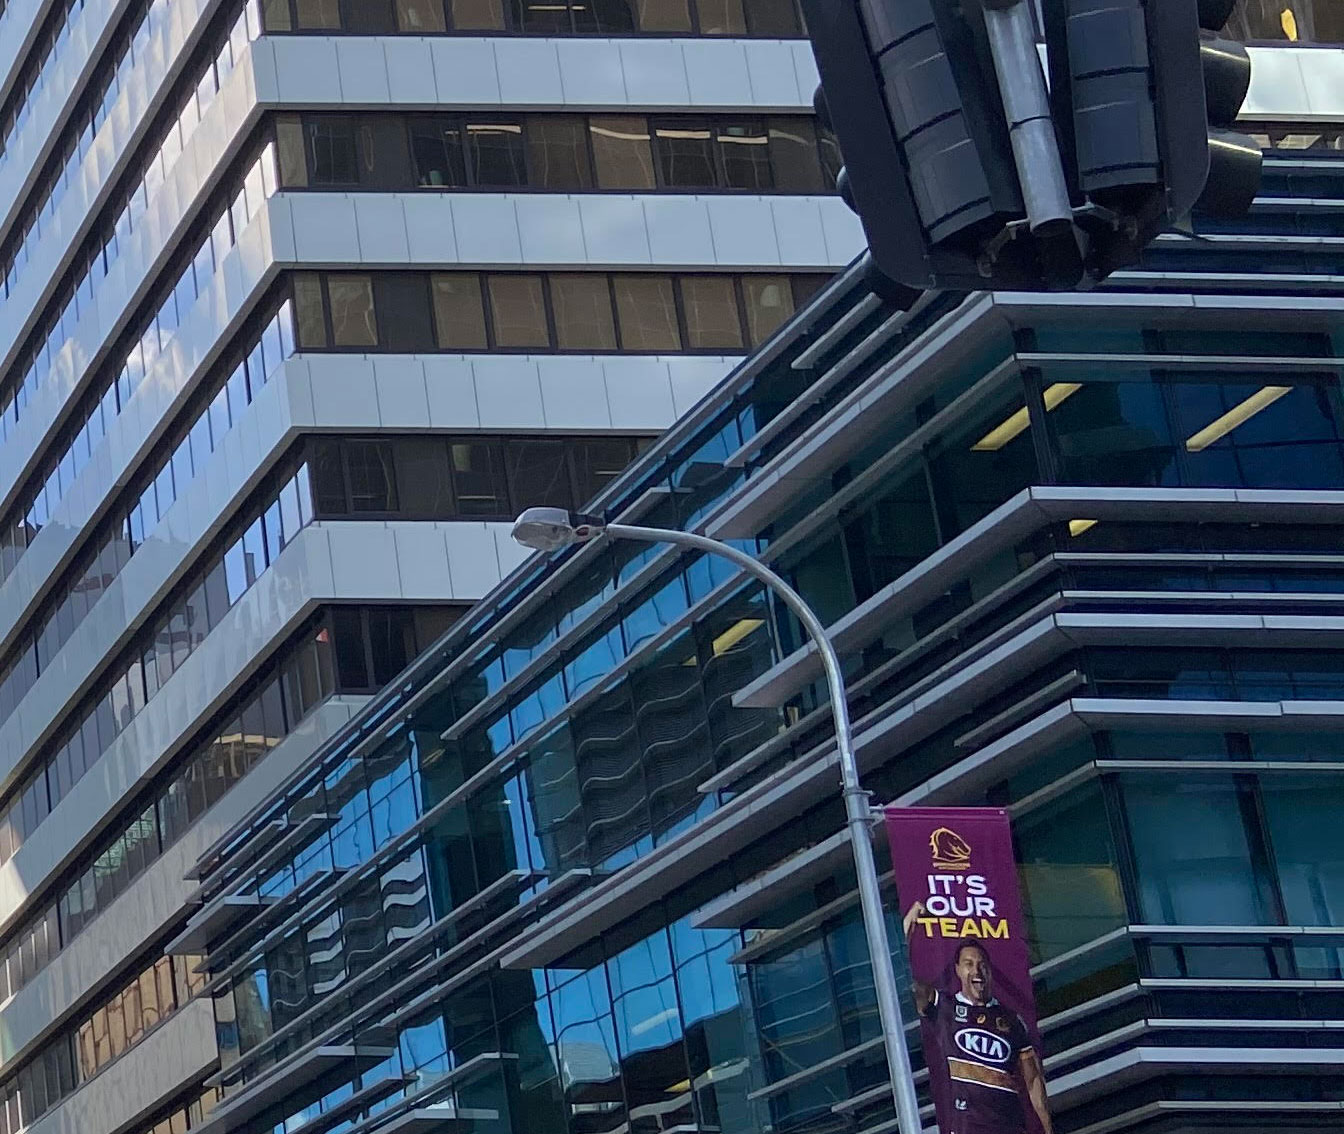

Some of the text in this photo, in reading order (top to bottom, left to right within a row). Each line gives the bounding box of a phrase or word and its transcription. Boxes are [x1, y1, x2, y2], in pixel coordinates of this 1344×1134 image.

[927, 874, 988, 896] IT'S
[926, 895, 997, 917] OUR
[916, 917, 1010, 939] TEAM
[964, 1032, 1003, 1059] KIA
